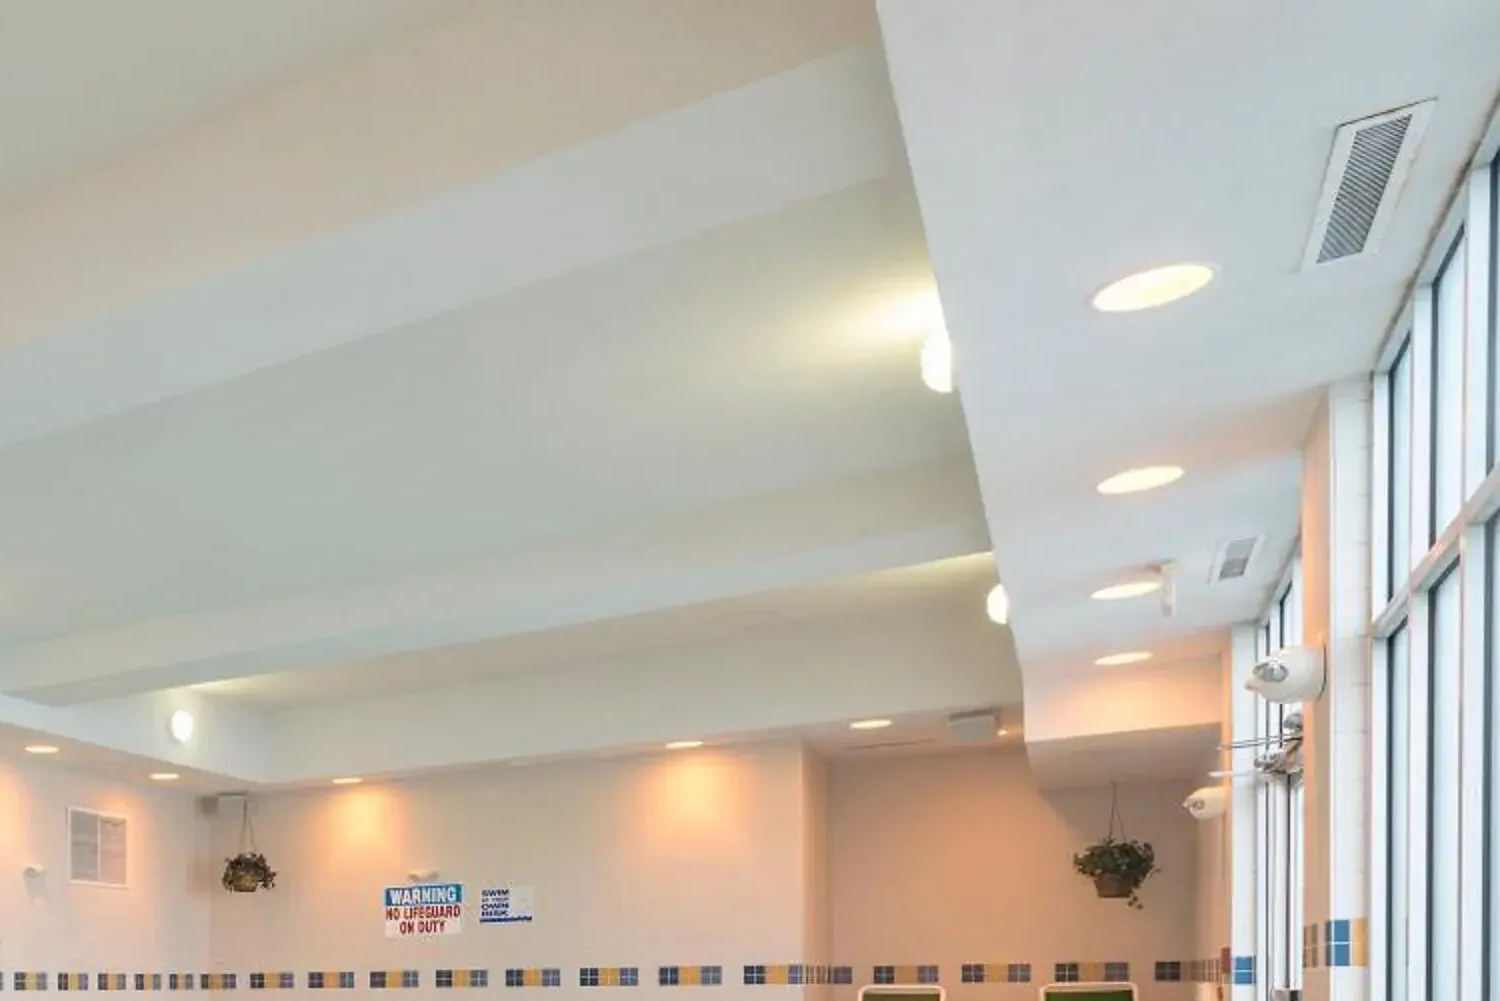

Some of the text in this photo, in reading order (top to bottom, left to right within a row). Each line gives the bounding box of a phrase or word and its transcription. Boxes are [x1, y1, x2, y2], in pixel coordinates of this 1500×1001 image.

[389, 886, 457, 905] WARNING
[386, 904, 461, 920] NO LIFEGUARD
[399, 919, 445, 934] ON DUTY
